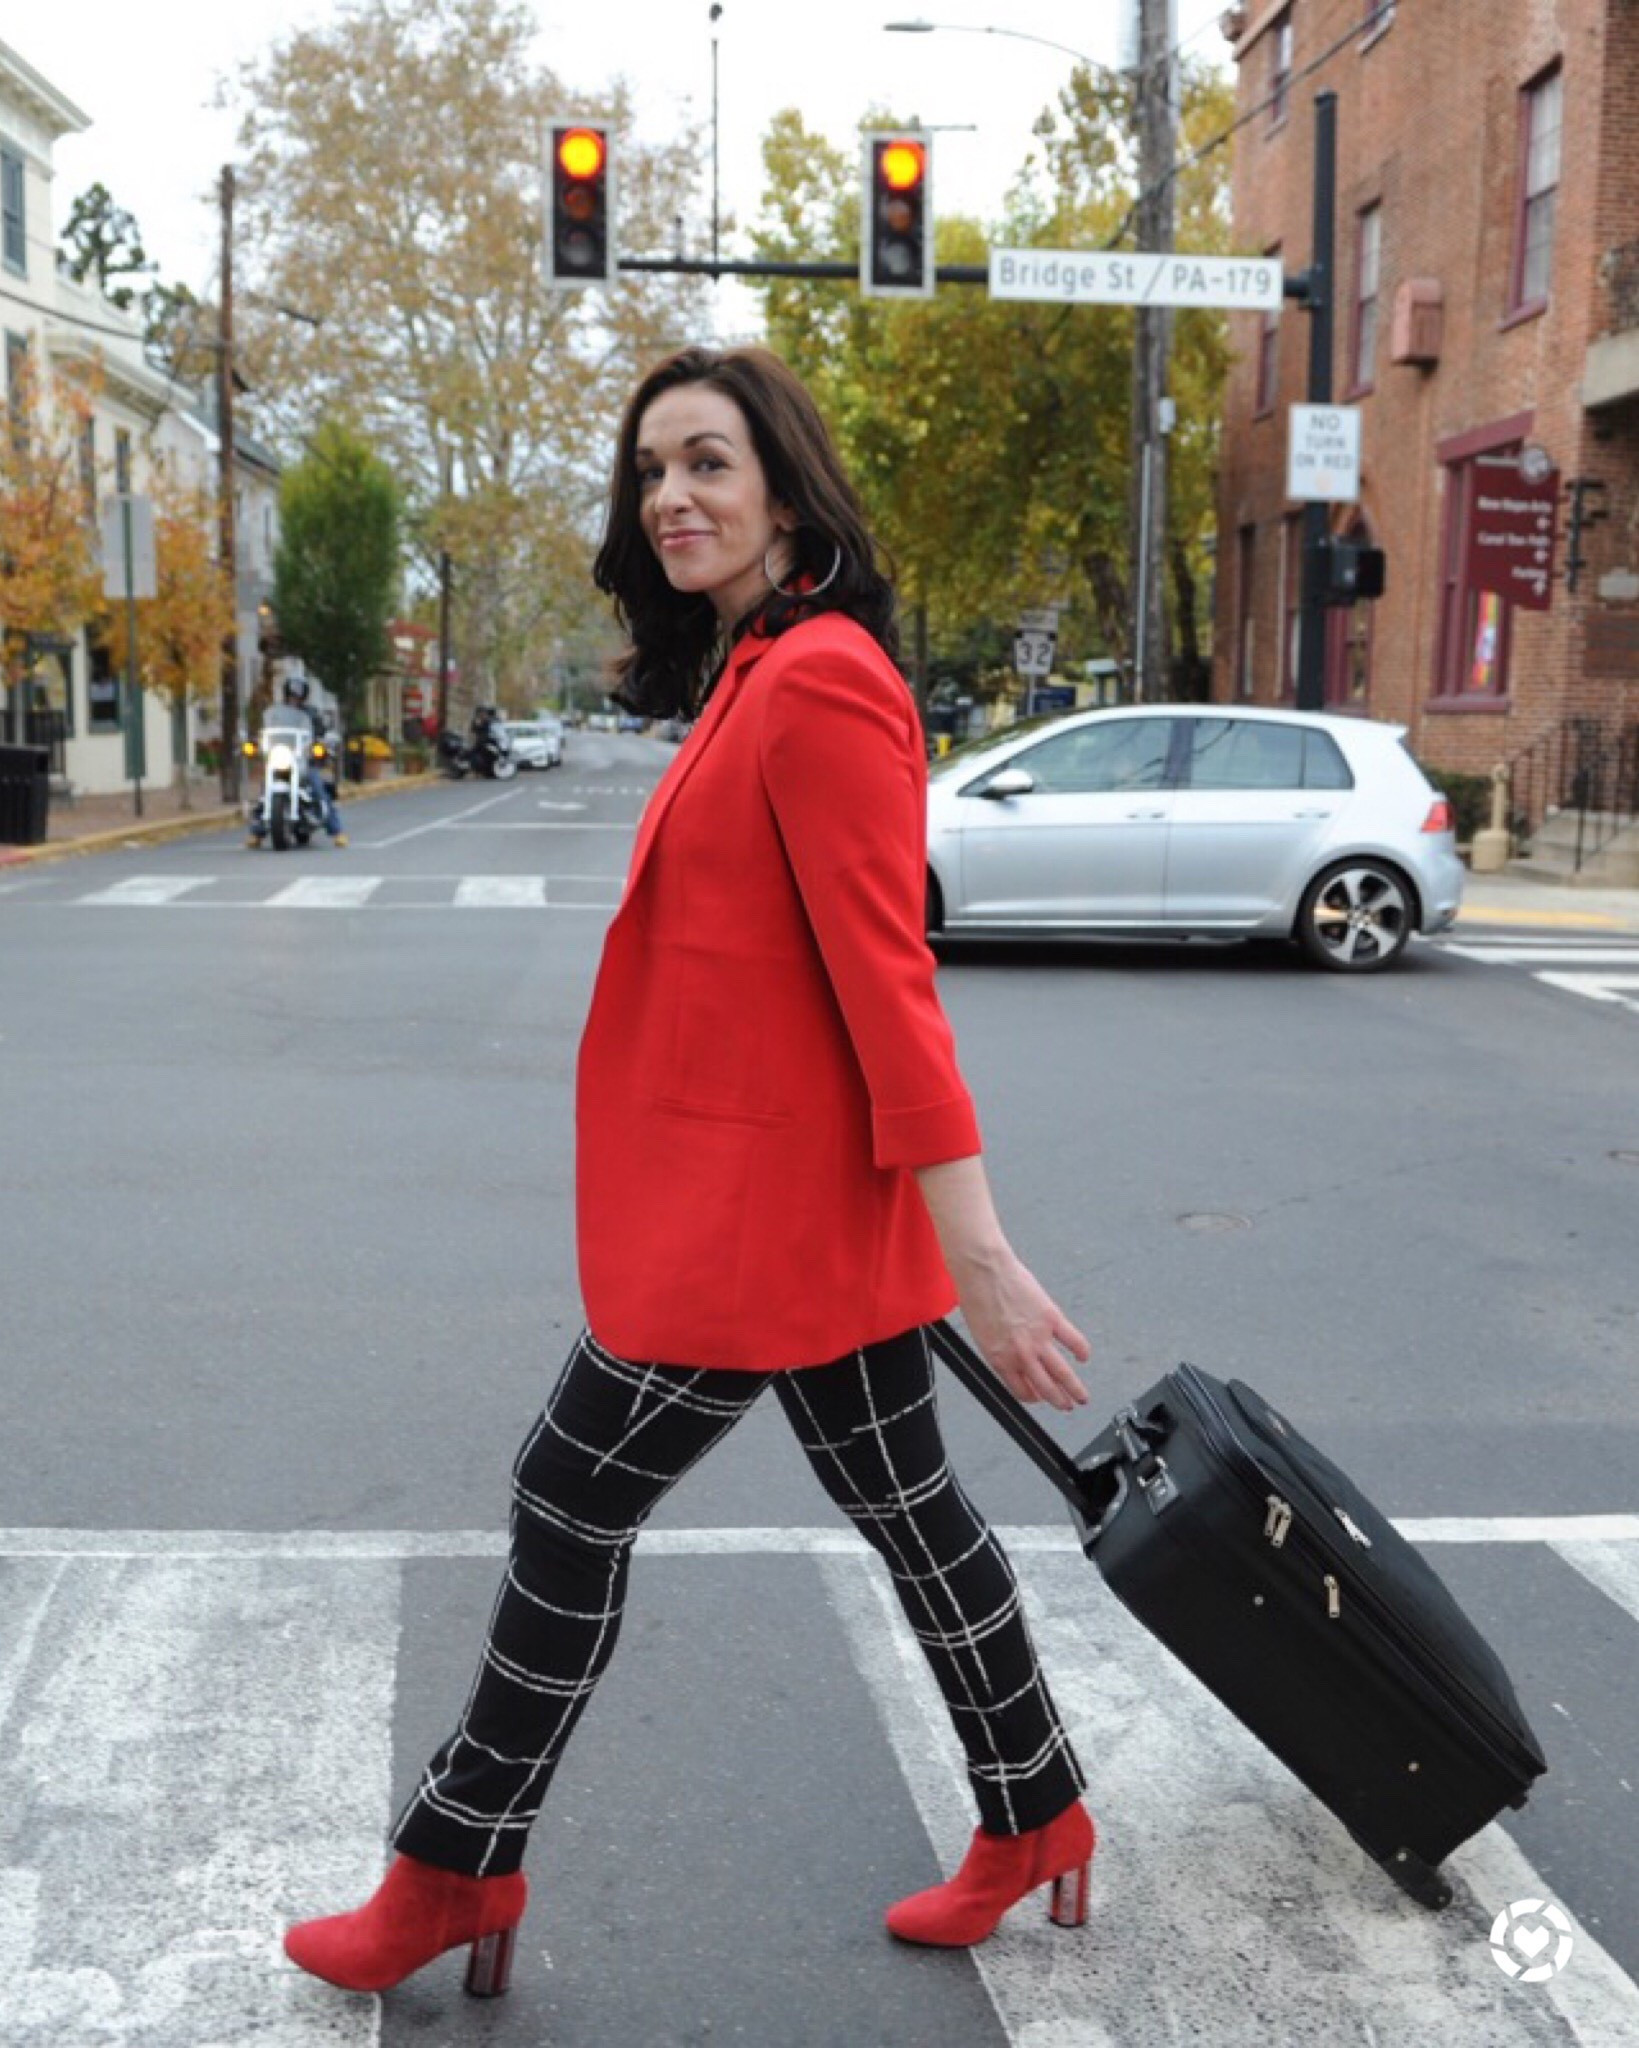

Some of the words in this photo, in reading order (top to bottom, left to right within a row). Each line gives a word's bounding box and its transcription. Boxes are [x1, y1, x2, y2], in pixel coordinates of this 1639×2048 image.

[1000, 258, 1096, 293] Bridge
[1107, 262, 1133, 290] St
[1172, 264, 1271, 294] PA-179
[1310, 412, 1341, 431] NO
[1018, 641, 1050, 665] 32
